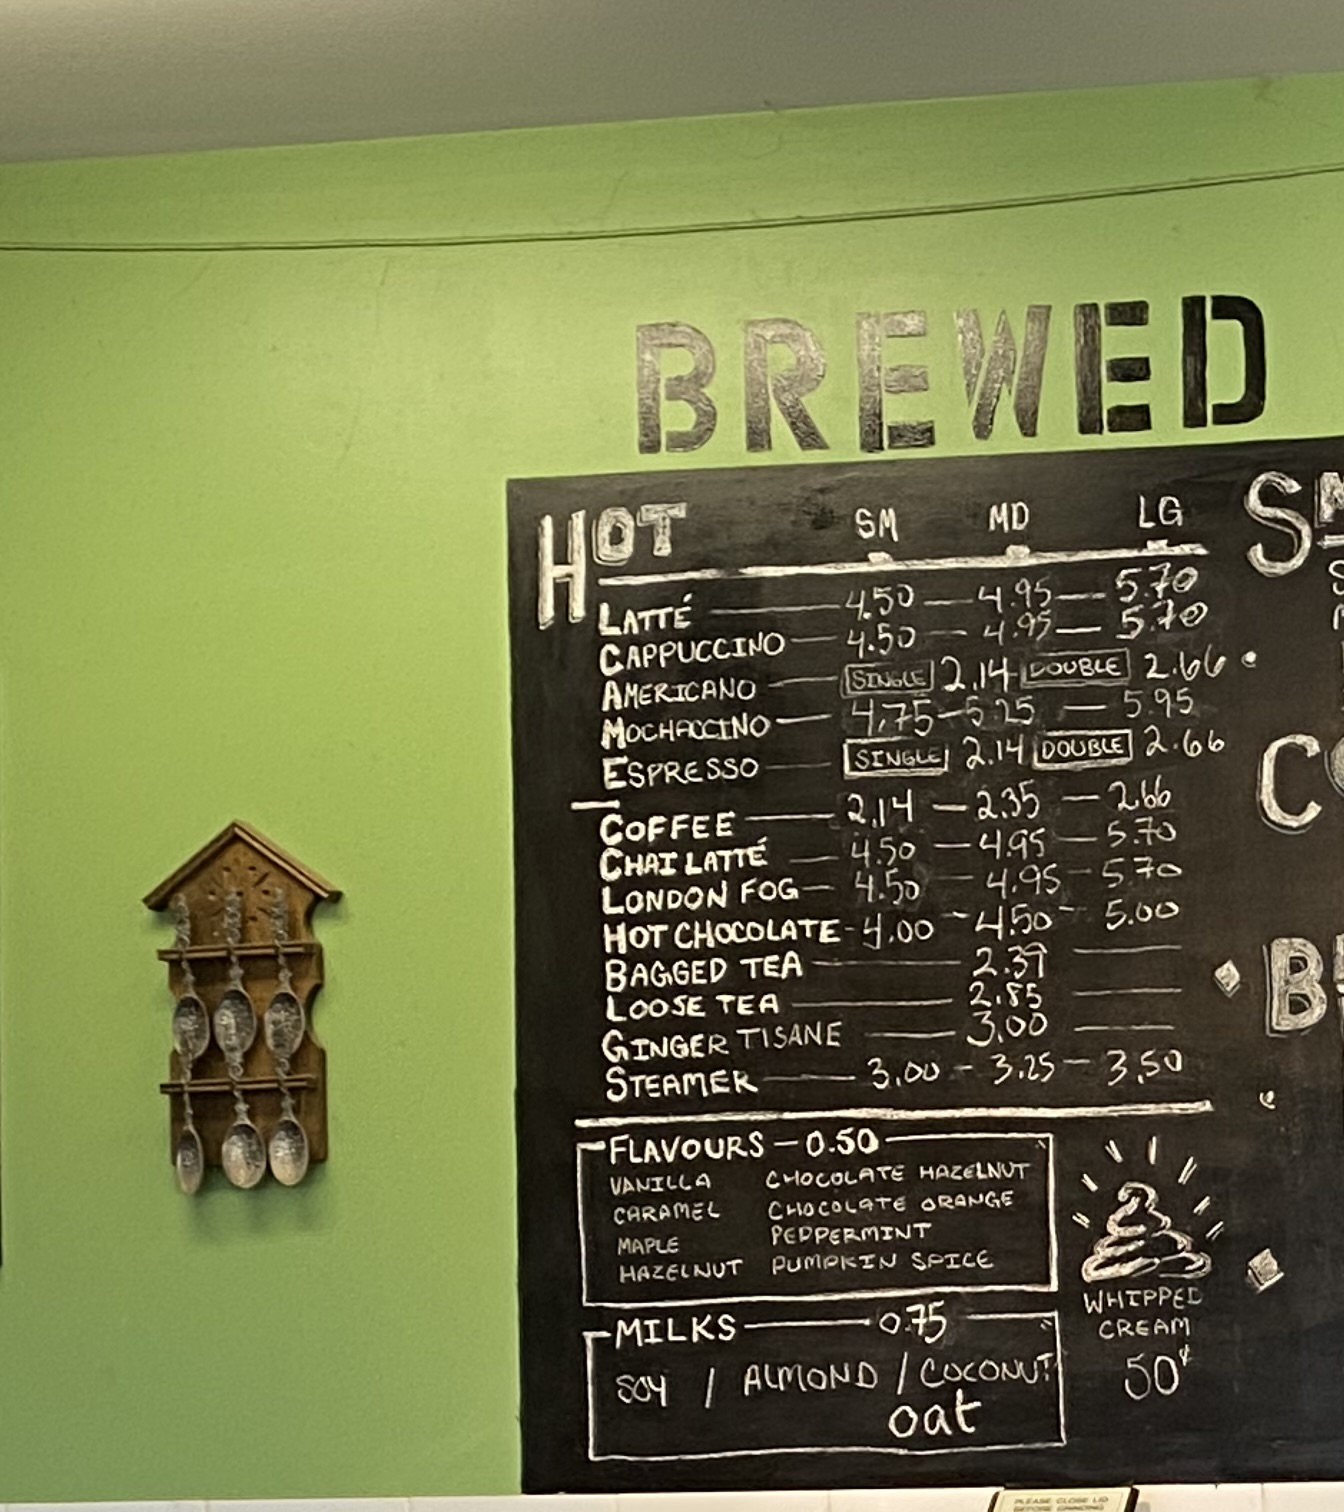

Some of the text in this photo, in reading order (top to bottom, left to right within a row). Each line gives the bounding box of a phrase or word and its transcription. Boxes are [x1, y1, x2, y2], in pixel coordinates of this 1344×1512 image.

[636, 295, 1266, 454] BREWED
[855, 496, 1182, 542] SM MD LG
[538, 503, 687, 630] HOT
[600, 631, 785, 673] CAPPUCCINO
[602, 678, 756, 711] AMERICANO
[603, 735, 1124, 789] ESPRESSO SINGLE DOUBLE
[600, 811, 735, 846] COFFEE
[600, 846, 677, 881] CHAI
[602, 876, 798, 915] LONDON FOG
[604, 918, 839, 953] HOT CHOCOLATE
[605, 952, 802, 991] BAGGED TEA
[605, 994, 778, 1022] LOOSE TEA
[601, 1022, 842, 1064] GINGER TISANE
[605, 1068, 758, 1101] STEAMER
[609, 1130, 879, 1162] FLAVOURS 0.50
[610, 1161, 1030, 1195] VANILLA CHOCOLATE HAZELNUT
[612, 1189, 1014, 1224] CARAMEL CHOCOLATE ORANGE
[618, 1222, 932, 1255] MAPLE PEPPERMINT
[619, 1249, 994, 1282] HAZELNUT PUMPKIN SPICE
[1083, 1287, 1201, 1312] WHIPPED
[615, 1315, 736, 1345] MILKS
[1100, 1315, 1190, 1338] CREAM
[617, 1354, 1053, 1406] SOY ALMOND COCONUT
[889, 1391, 982, 1439] oat
